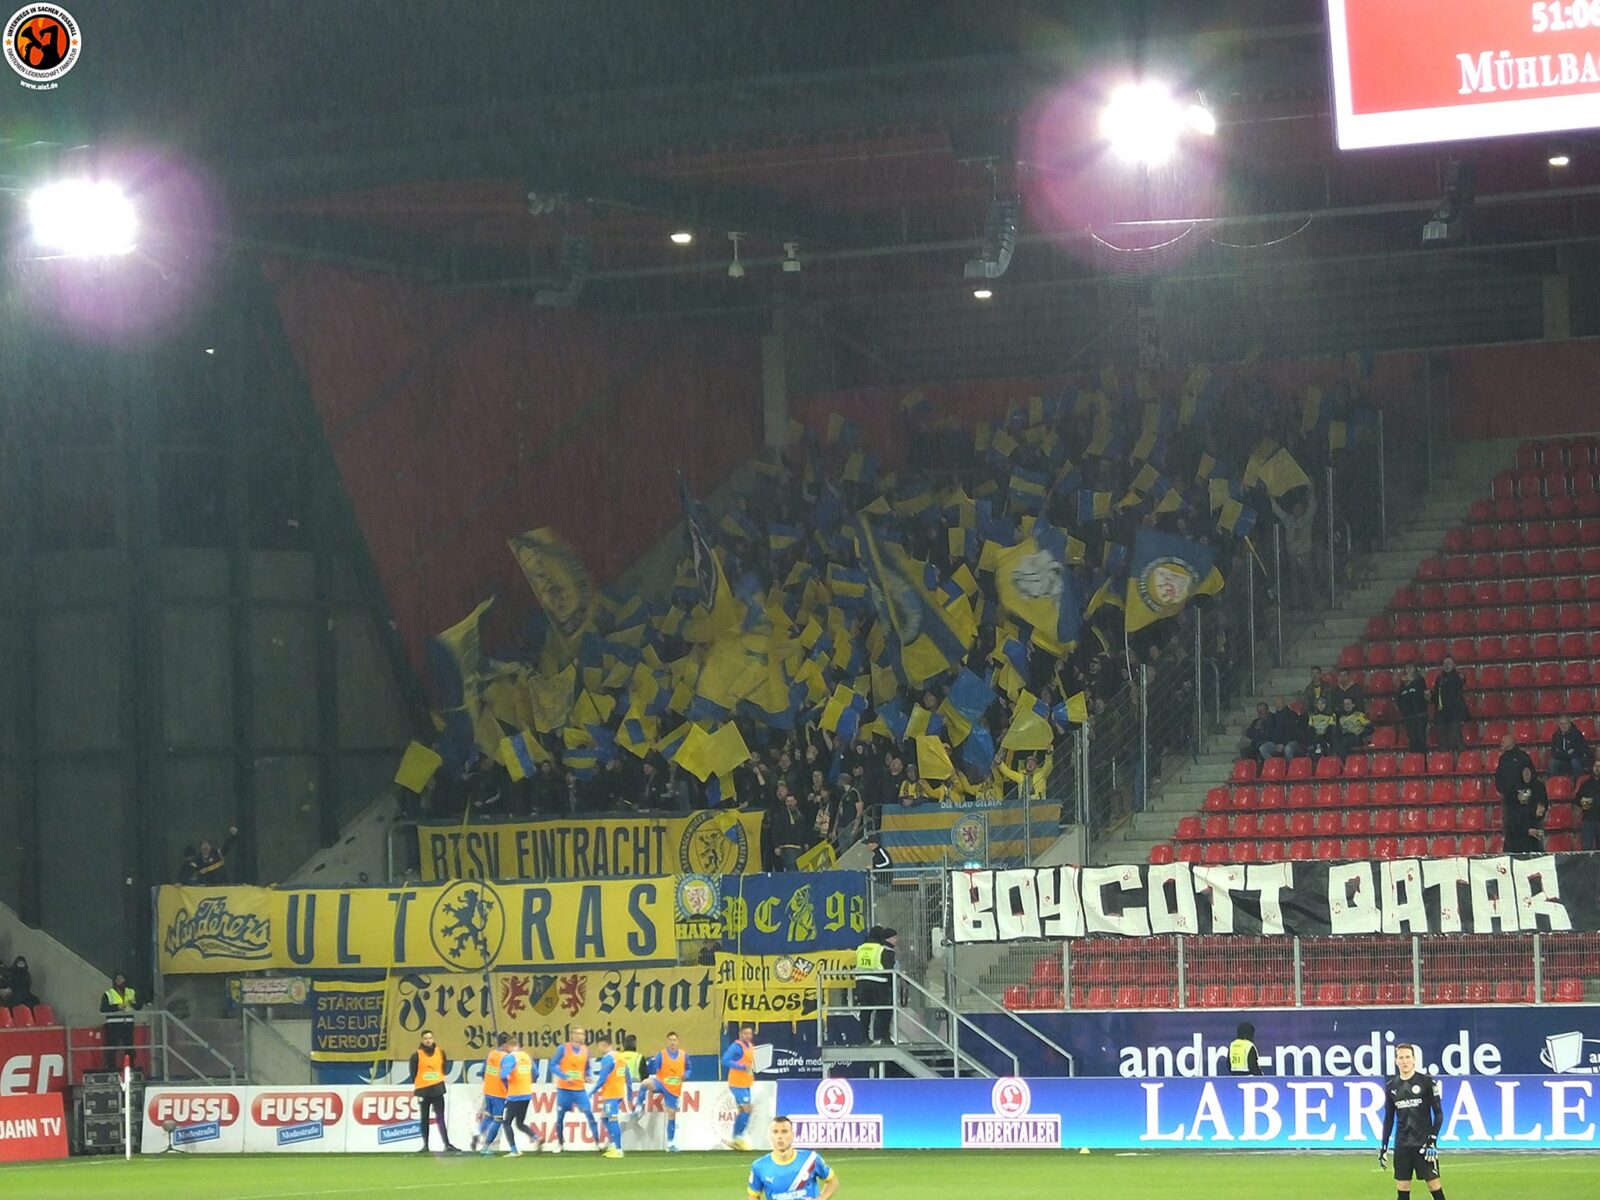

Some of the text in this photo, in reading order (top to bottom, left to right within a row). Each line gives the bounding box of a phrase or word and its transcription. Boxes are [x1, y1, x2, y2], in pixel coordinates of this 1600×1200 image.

[1456, 50, 1600, 94] MÜHLBA
[430, 825, 667, 881] BTSV EINTRACHT
[952, 854, 1573, 942] BOYCOTT QATAR
[675, 923, 722, 940] HARZ
[399, 973, 493, 1032] Frei
[727, 992, 800, 1011] CHAOS
[1119, 1031, 1501, 1078] andr-medi.de
[157, 1097, 234, 1123] FUSSL
[260, 1096, 338, 1122] FUSSL
[361, 1096, 435, 1121] FUSS
[1139, 1080, 1597, 1143] LABERALE
[40, 1116, 62, 1138] TV
[968, 1121, 1056, 1143] LABERTALER
